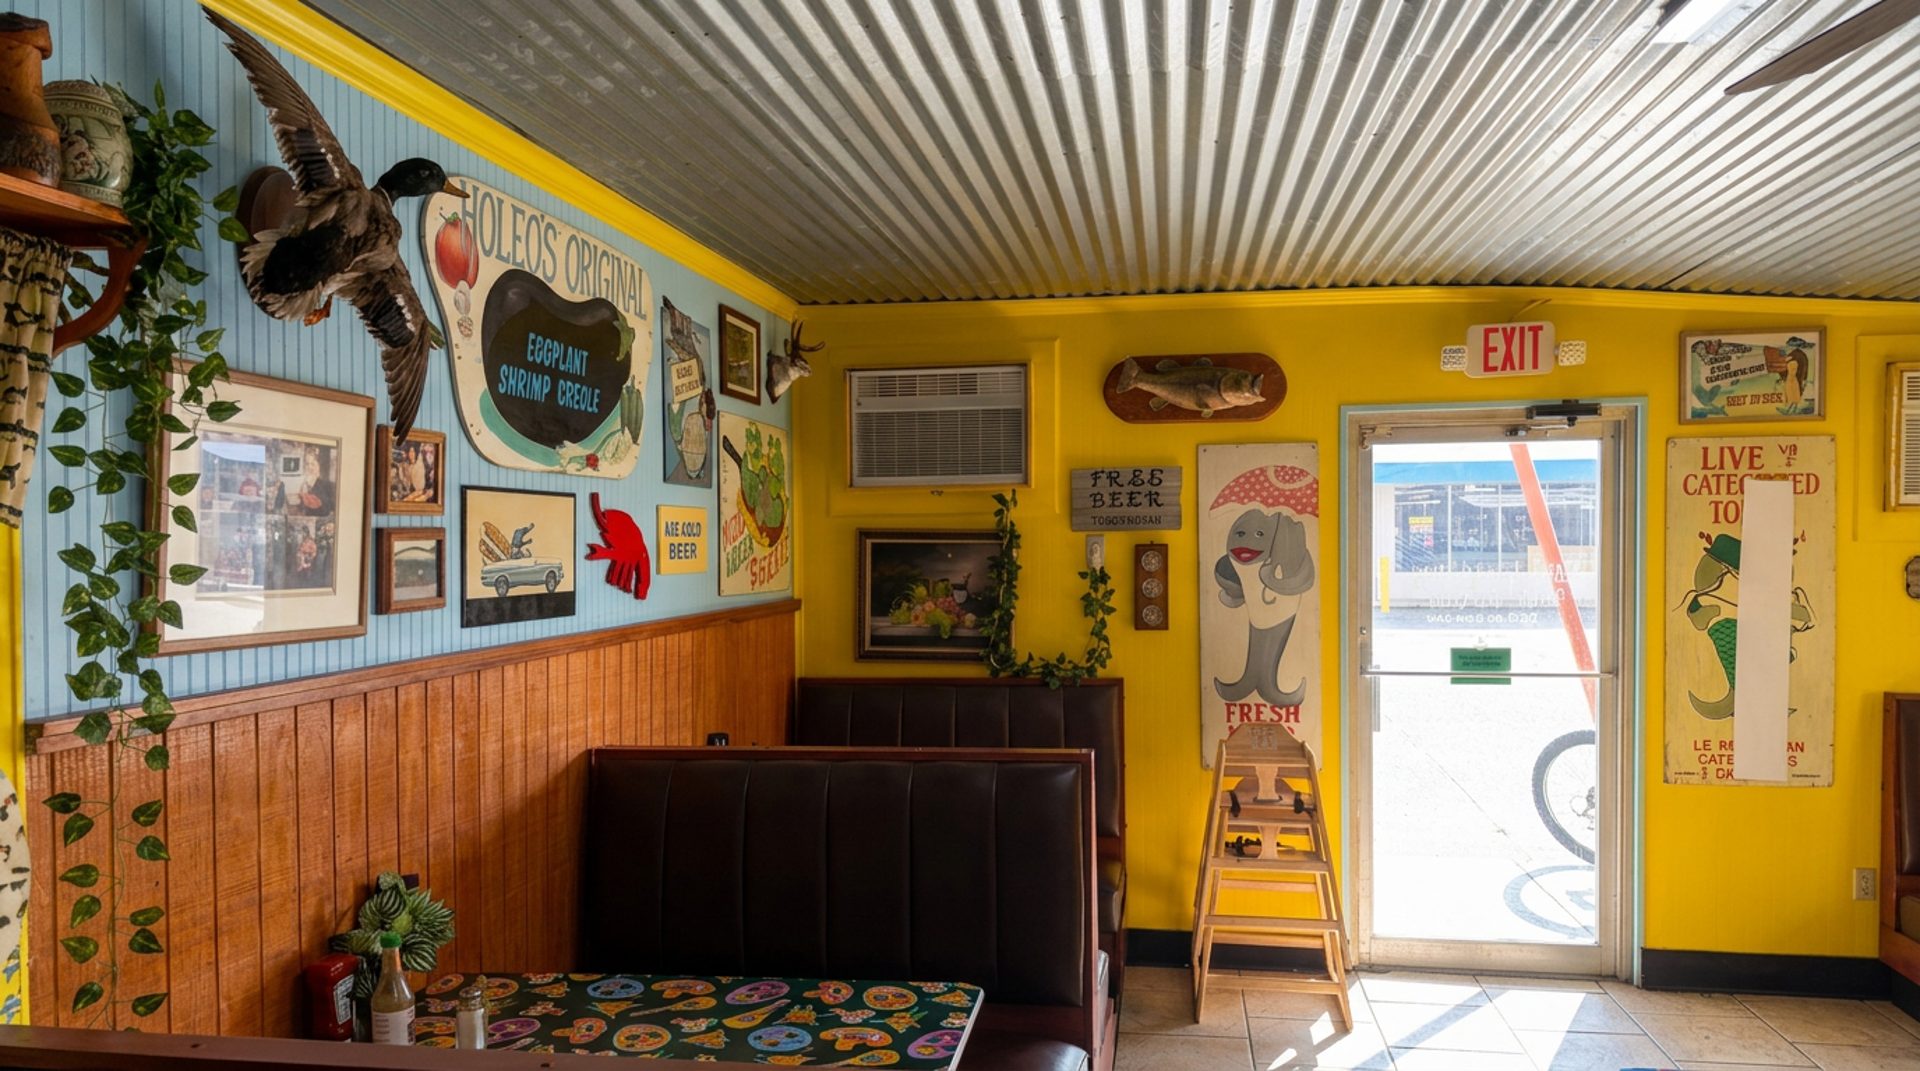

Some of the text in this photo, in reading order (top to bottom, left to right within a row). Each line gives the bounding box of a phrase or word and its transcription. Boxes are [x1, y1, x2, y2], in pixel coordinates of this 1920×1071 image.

[565, 234, 647, 320] ORIGINAL
[1483, 325, 1543, 372] EXIT
[498, 364, 601, 414] SHRIMP CREOLE
[1701, 446, 1764, 470] LIVE
[1089, 490, 1164, 508] BEER
[669, 543, 697, 560] BEER
[1225, 703, 1300, 723] FRESH
[1693, 740, 1711, 751] LE
